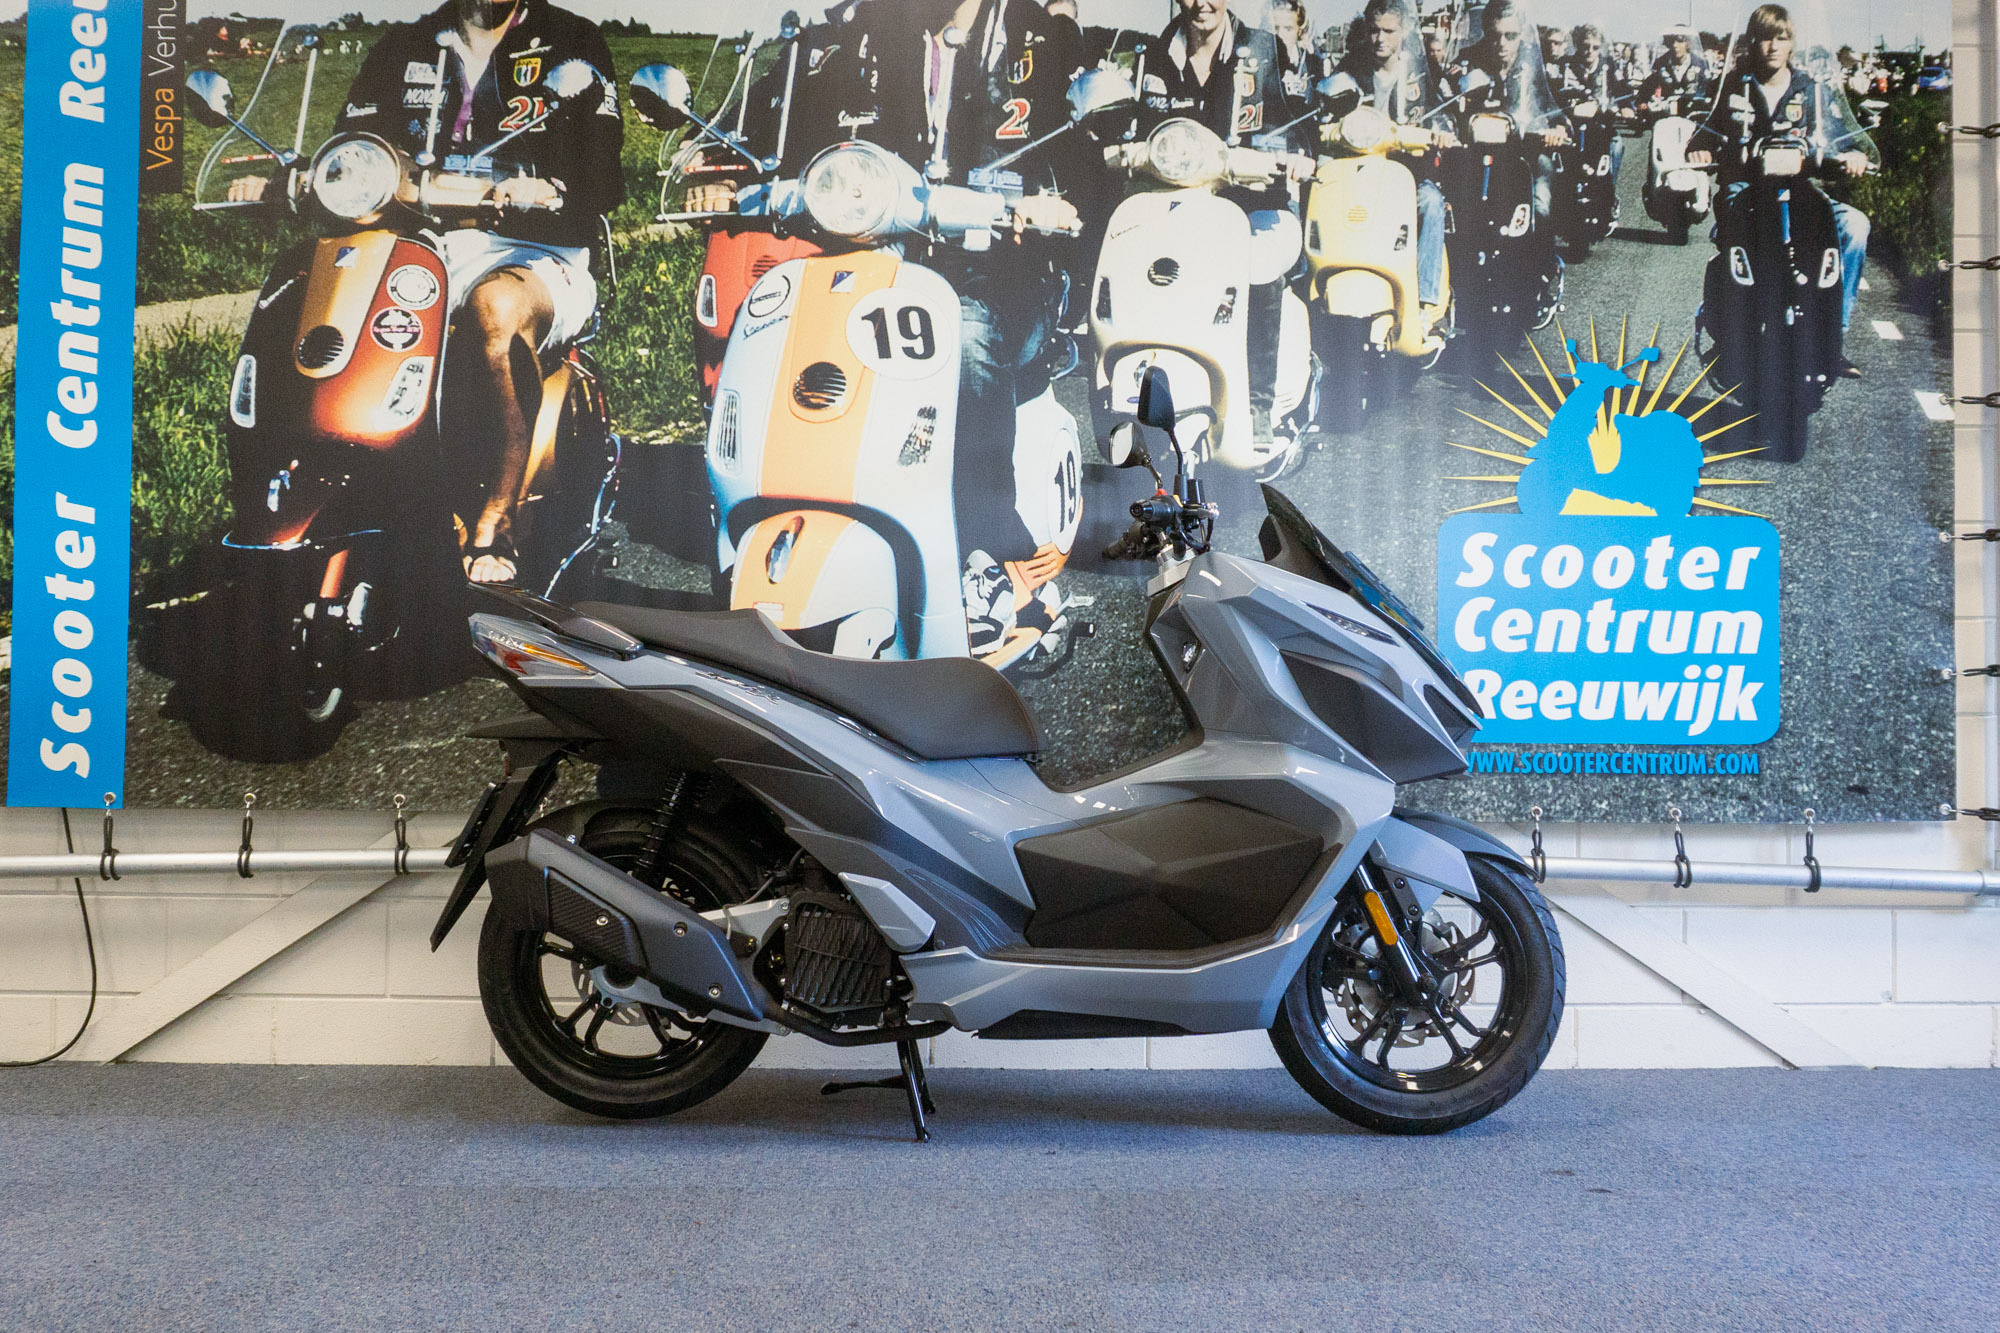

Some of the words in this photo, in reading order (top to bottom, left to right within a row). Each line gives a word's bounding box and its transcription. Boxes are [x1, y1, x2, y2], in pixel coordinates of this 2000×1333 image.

[59, 0, 108, 123] Ree
[146, 88, 182, 170] Vespa
[46, 162, 104, 449] Centrum
[861, 305, 937, 361] 19
[1053, 449, 1077, 533] 19
[1454, 531, 1762, 591] Scooter
[40, 491, 96, 779] Scooter
[1454, 596, 1764, 655] Centrum
[1462, 664, 1765, 737] Reeuwijk
